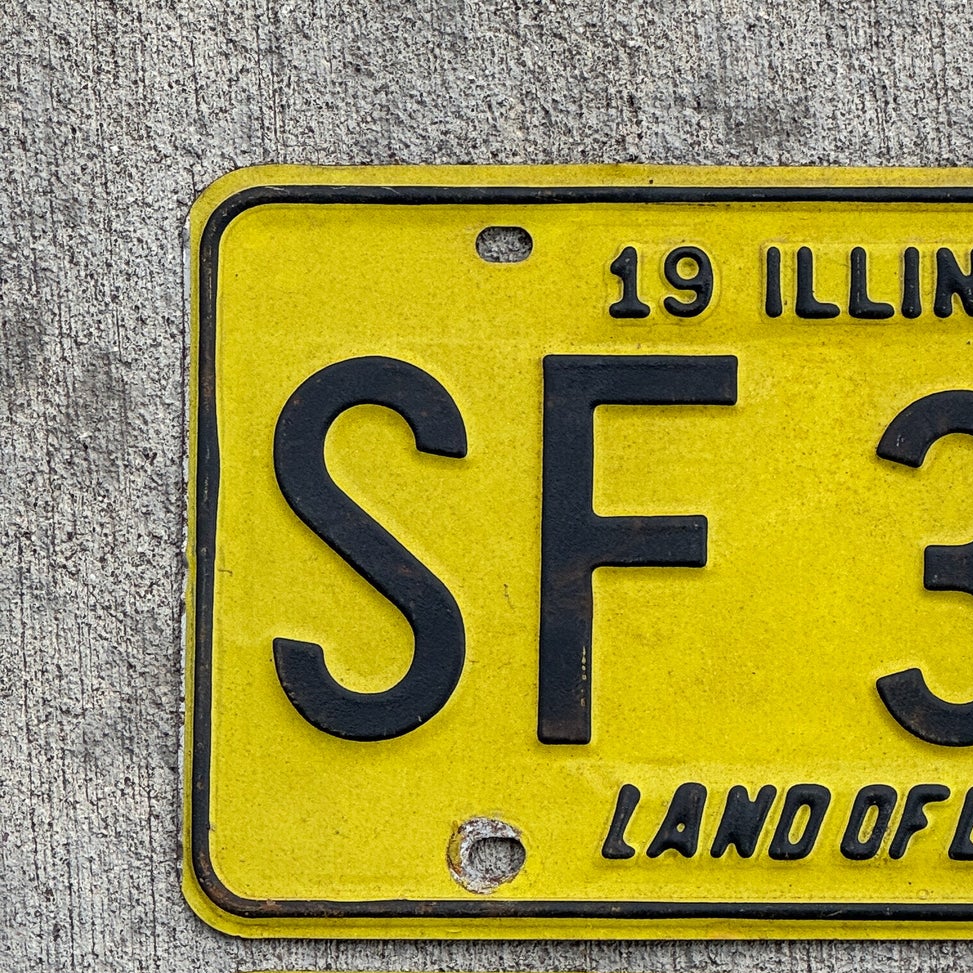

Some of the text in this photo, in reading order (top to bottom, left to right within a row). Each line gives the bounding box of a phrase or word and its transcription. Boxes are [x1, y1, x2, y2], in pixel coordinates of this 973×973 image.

[609, 247, 713, 318] 19
[273, 355, 738, 745] SF
[602, 783, 831, 861] LAND
[841, 784, 949, 860] OF
